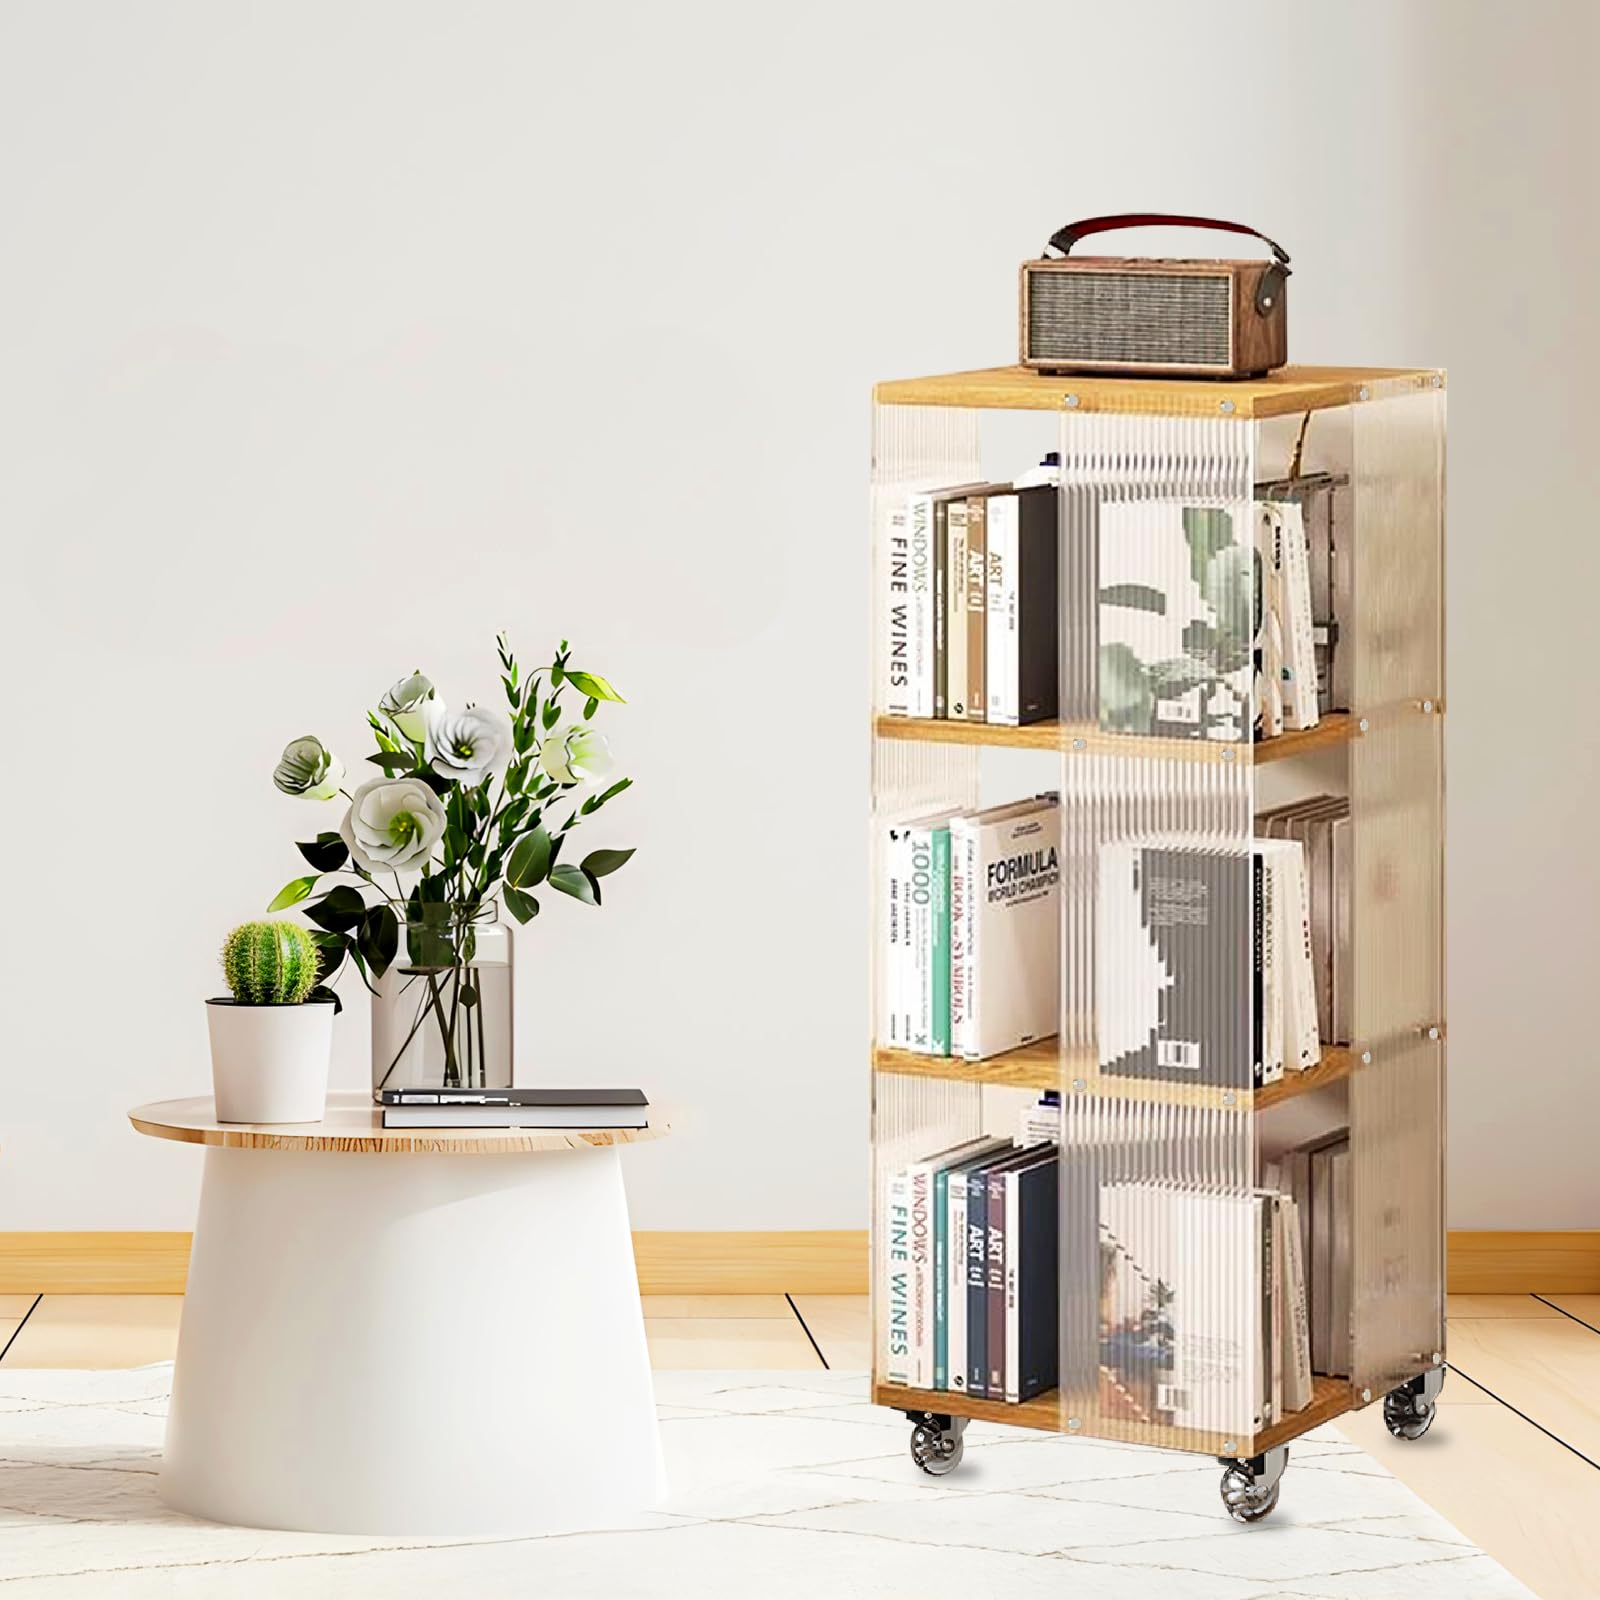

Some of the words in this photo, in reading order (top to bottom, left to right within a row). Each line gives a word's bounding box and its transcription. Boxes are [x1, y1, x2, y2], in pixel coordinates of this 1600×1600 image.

[890, 537, 908, 593] FINE
[912, 502, 928, 594] WINDOWS
[989, 551, 1003, 587] ART
[890, 605, 908, 687] WINES
[912, 841, 930, 905] 1000
[987, 846, 1059, 889] FORMULA
[890, 1205, 908, 1261] FINE
[911, 1173, 928, 1265] WINDOWS
[968, 1224, 985, 1262] ART
[987, 1225, 1004, 1264] ART
[890, 1273, 908, 1356] WINES
